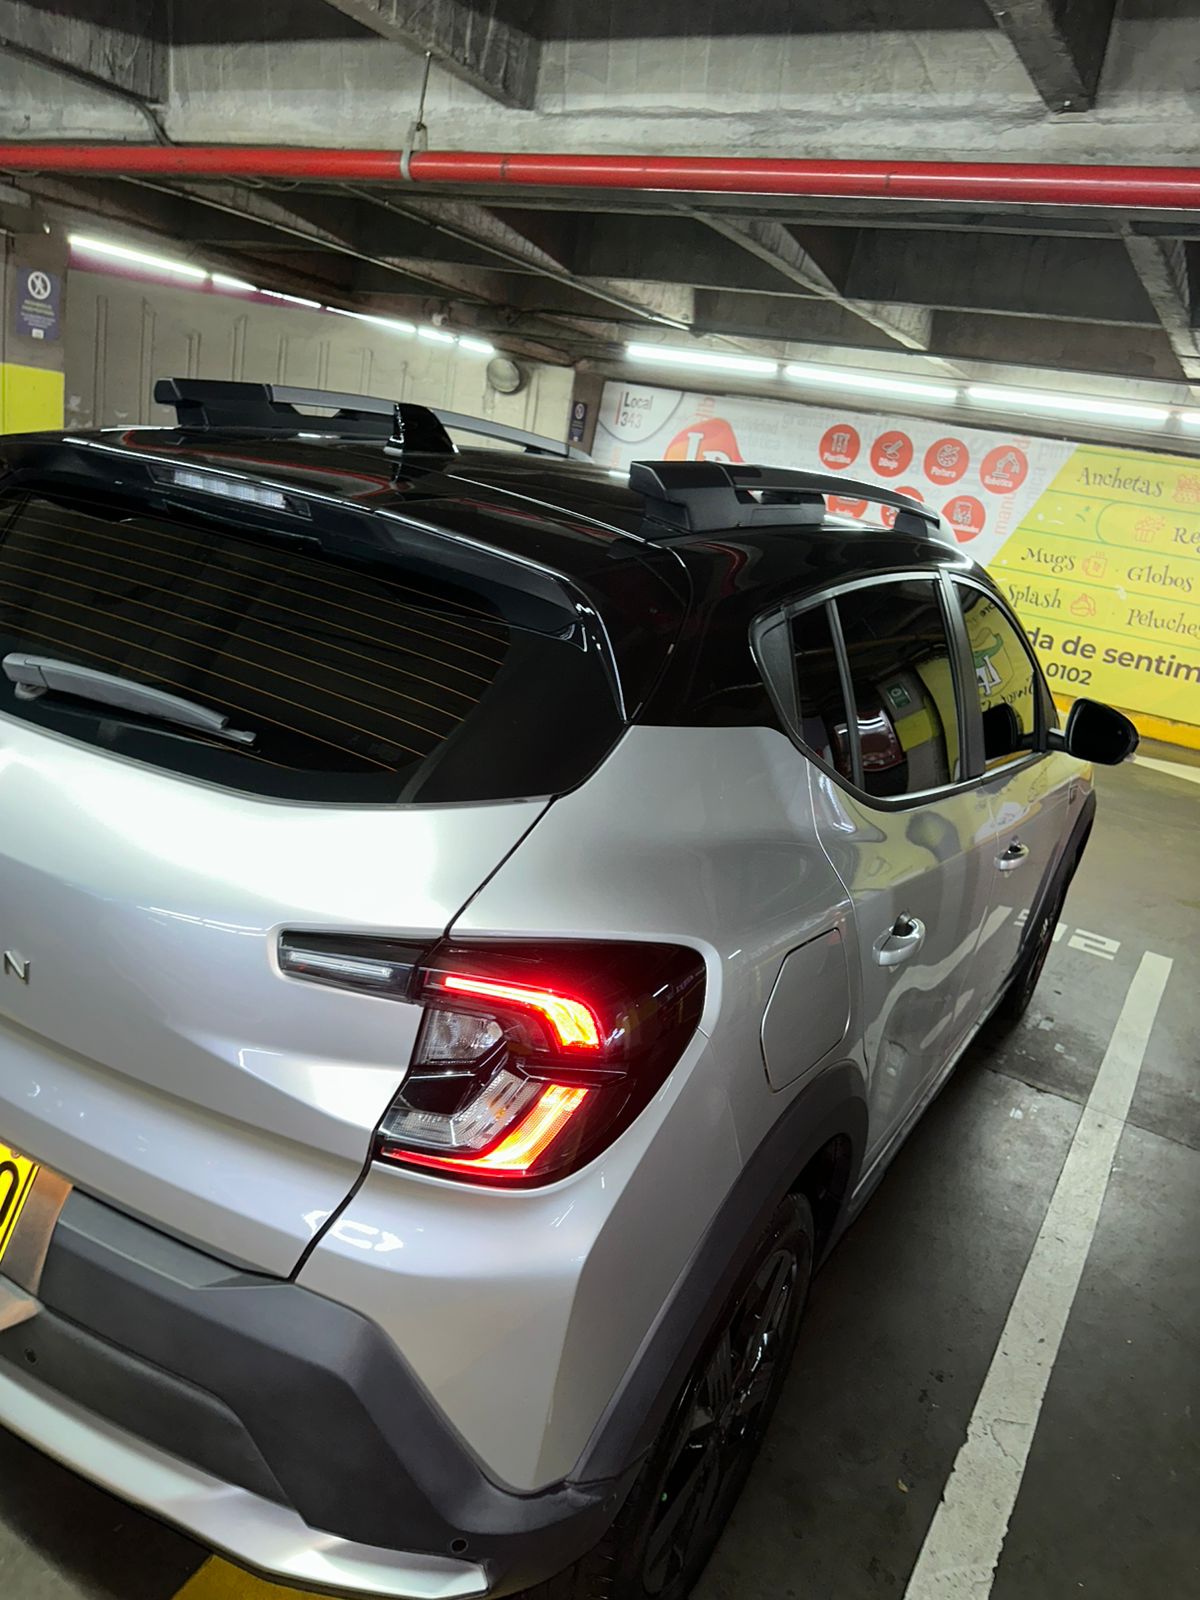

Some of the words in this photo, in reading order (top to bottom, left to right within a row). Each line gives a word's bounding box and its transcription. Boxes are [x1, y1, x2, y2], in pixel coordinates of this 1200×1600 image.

[623, 391, 654, 410] Local
[1076, 467, 1164, 498] Anchetas
[1021, 548, 1076, 573] Mugs
[1127, 564, 1194, 593] Globos
[1006, 584, 1062, 609] Splash
[1061, 635, 1097, 660] de
[1045, 662, 1093, 686] 0102
[4, 950, 31, 985] N
